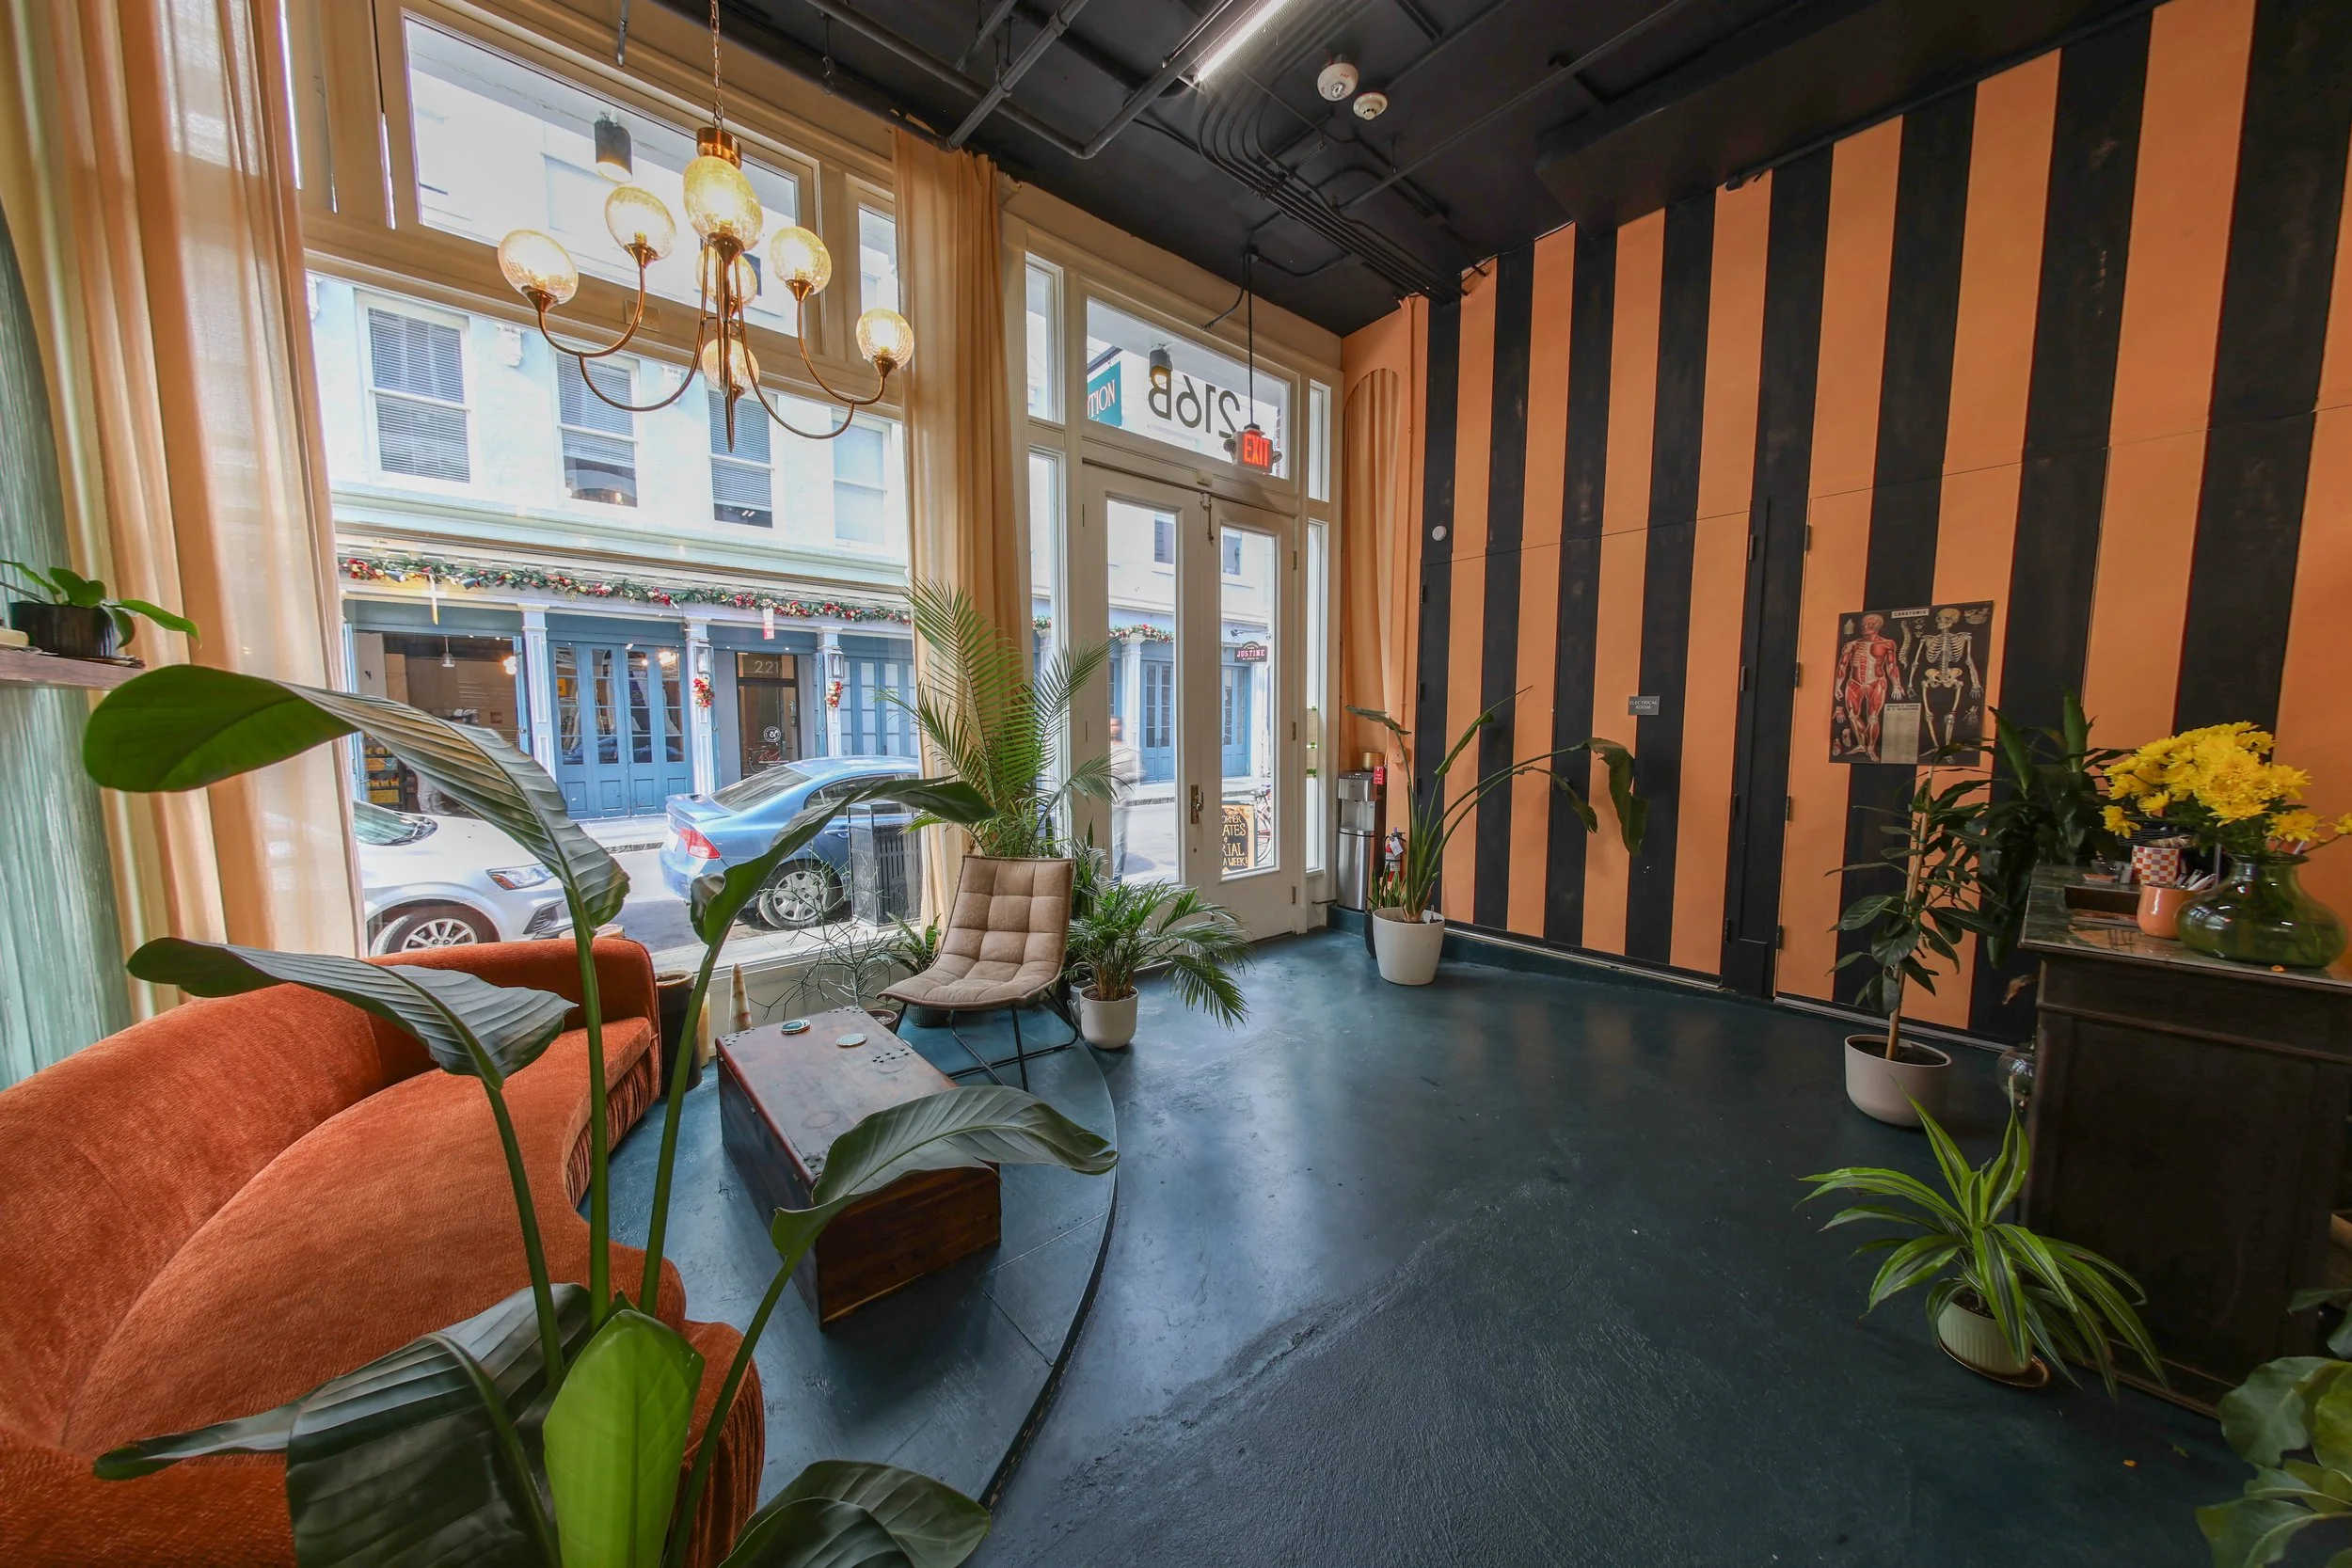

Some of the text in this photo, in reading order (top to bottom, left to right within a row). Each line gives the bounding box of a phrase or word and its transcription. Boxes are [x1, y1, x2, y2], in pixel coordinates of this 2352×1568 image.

[1244, 434, 1269, 467] EXIT
[1236, 649, 1265, 657] JUSTINE
[754, 660, 779, 673] 221
[1228, 857, 1248, 866] WEEK!
